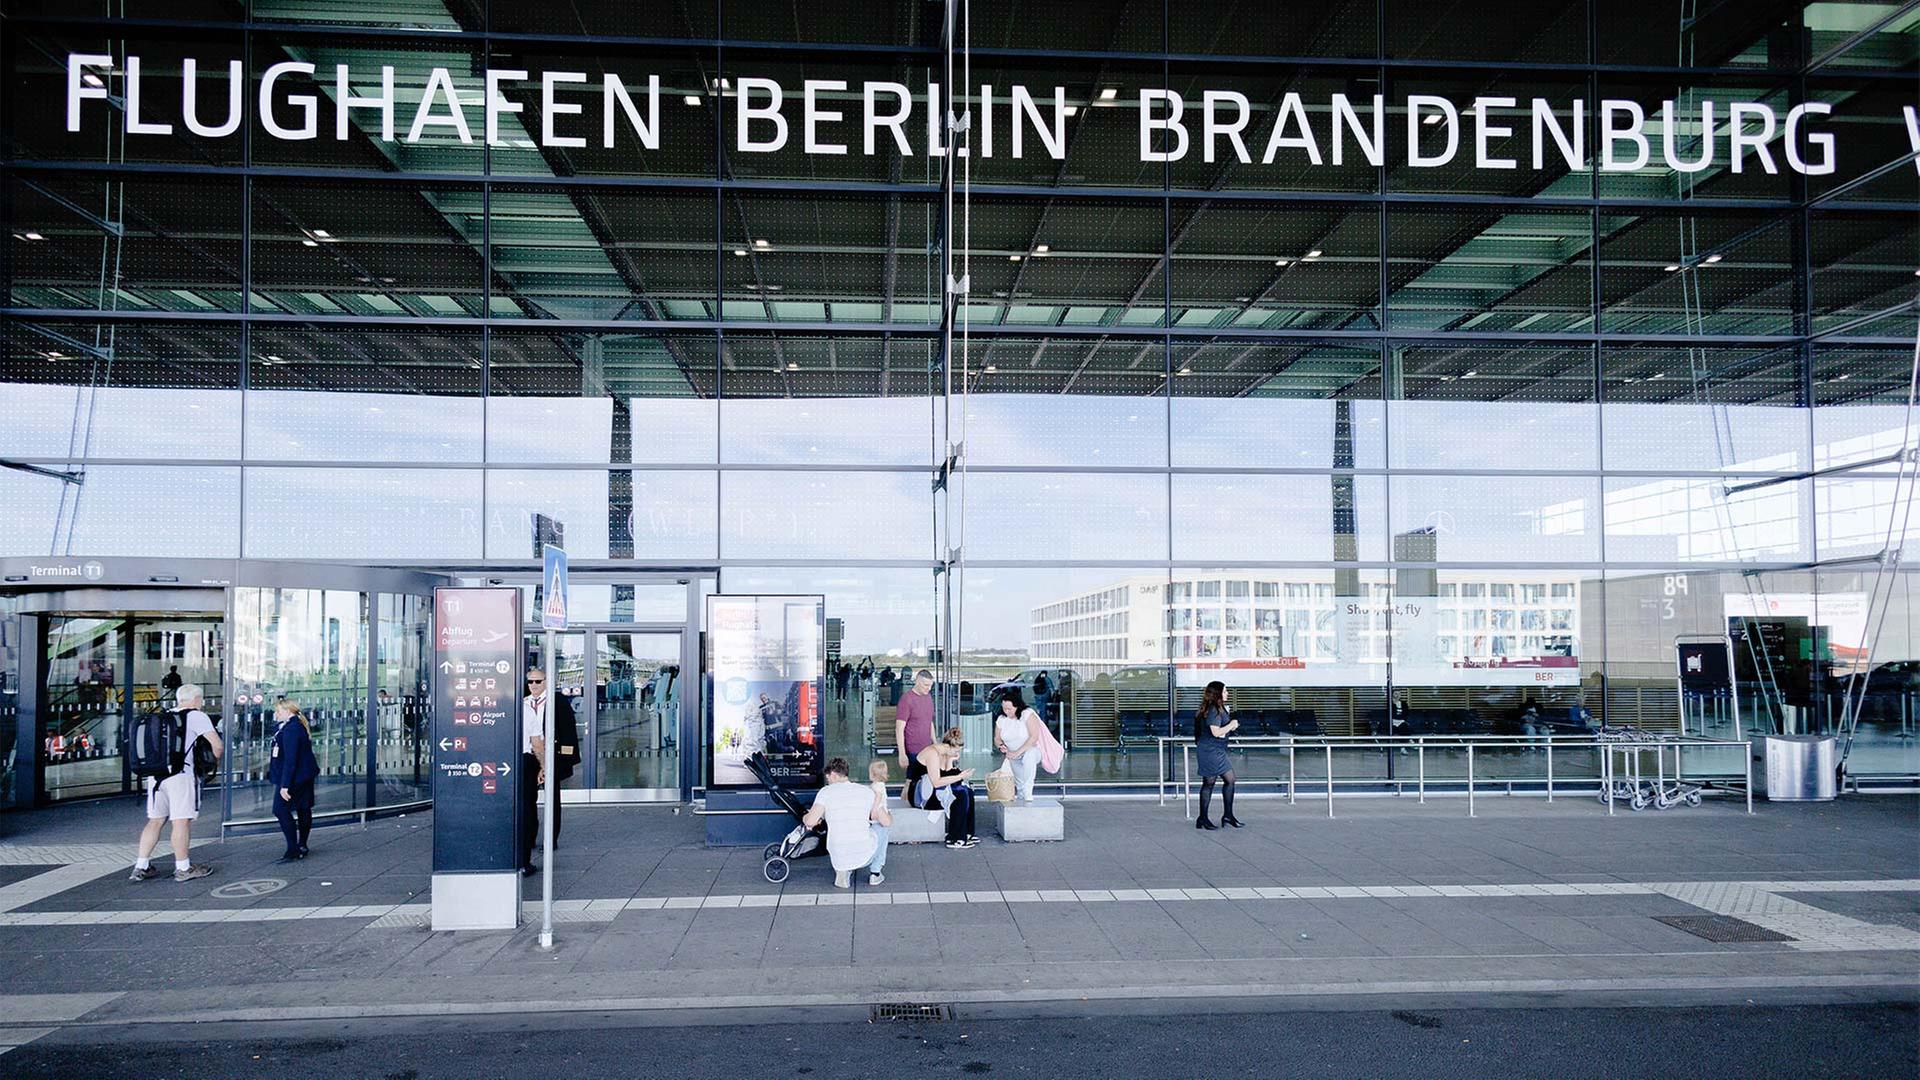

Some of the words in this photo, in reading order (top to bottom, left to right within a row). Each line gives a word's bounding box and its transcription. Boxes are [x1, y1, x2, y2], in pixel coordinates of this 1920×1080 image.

[66, 53, 661, 150] FLUGHAFEN
[736, 77, 1067, 160] BERLIN
[1139, 88, 1837, 176] BRANDENBURG
[30, 565, 82, 577] Terminal
[86, 565, 102, 577] T1
[1346, 604, 1381, 616] Sho,
[1405, 604, 1421, 617] fly
[441, 626, 473, 637] Abflug
[1535, 672, 1554, 681] BER
[454, 739, 466, 749] P1
